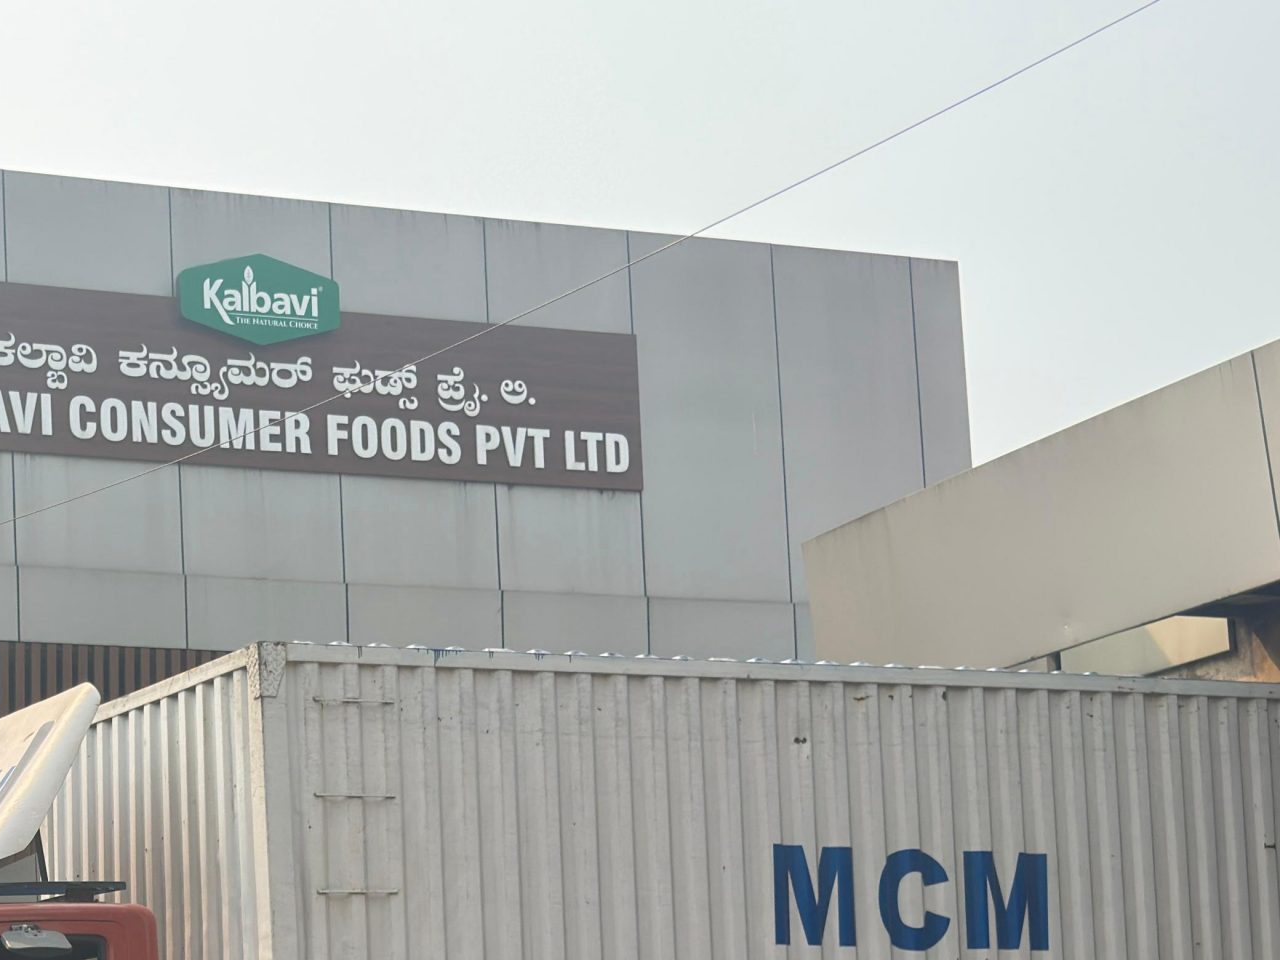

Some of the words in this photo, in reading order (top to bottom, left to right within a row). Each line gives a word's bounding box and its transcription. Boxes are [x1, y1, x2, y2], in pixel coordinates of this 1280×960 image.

[203, 277, 319, 325] Kalbavi
[236, 316, 251, 325] THE
[252, 318, 288, 328] NATURAL
[289, 320, 319, 330] CHOICE
[69, 395, 313, 455] CONSUMER
[327, 413, 462, 465] FOODS
[476, 424, 551, 469] PVT
[564, 430, 630, 474] LTD
[773, 843, 1050, 951] MCM
